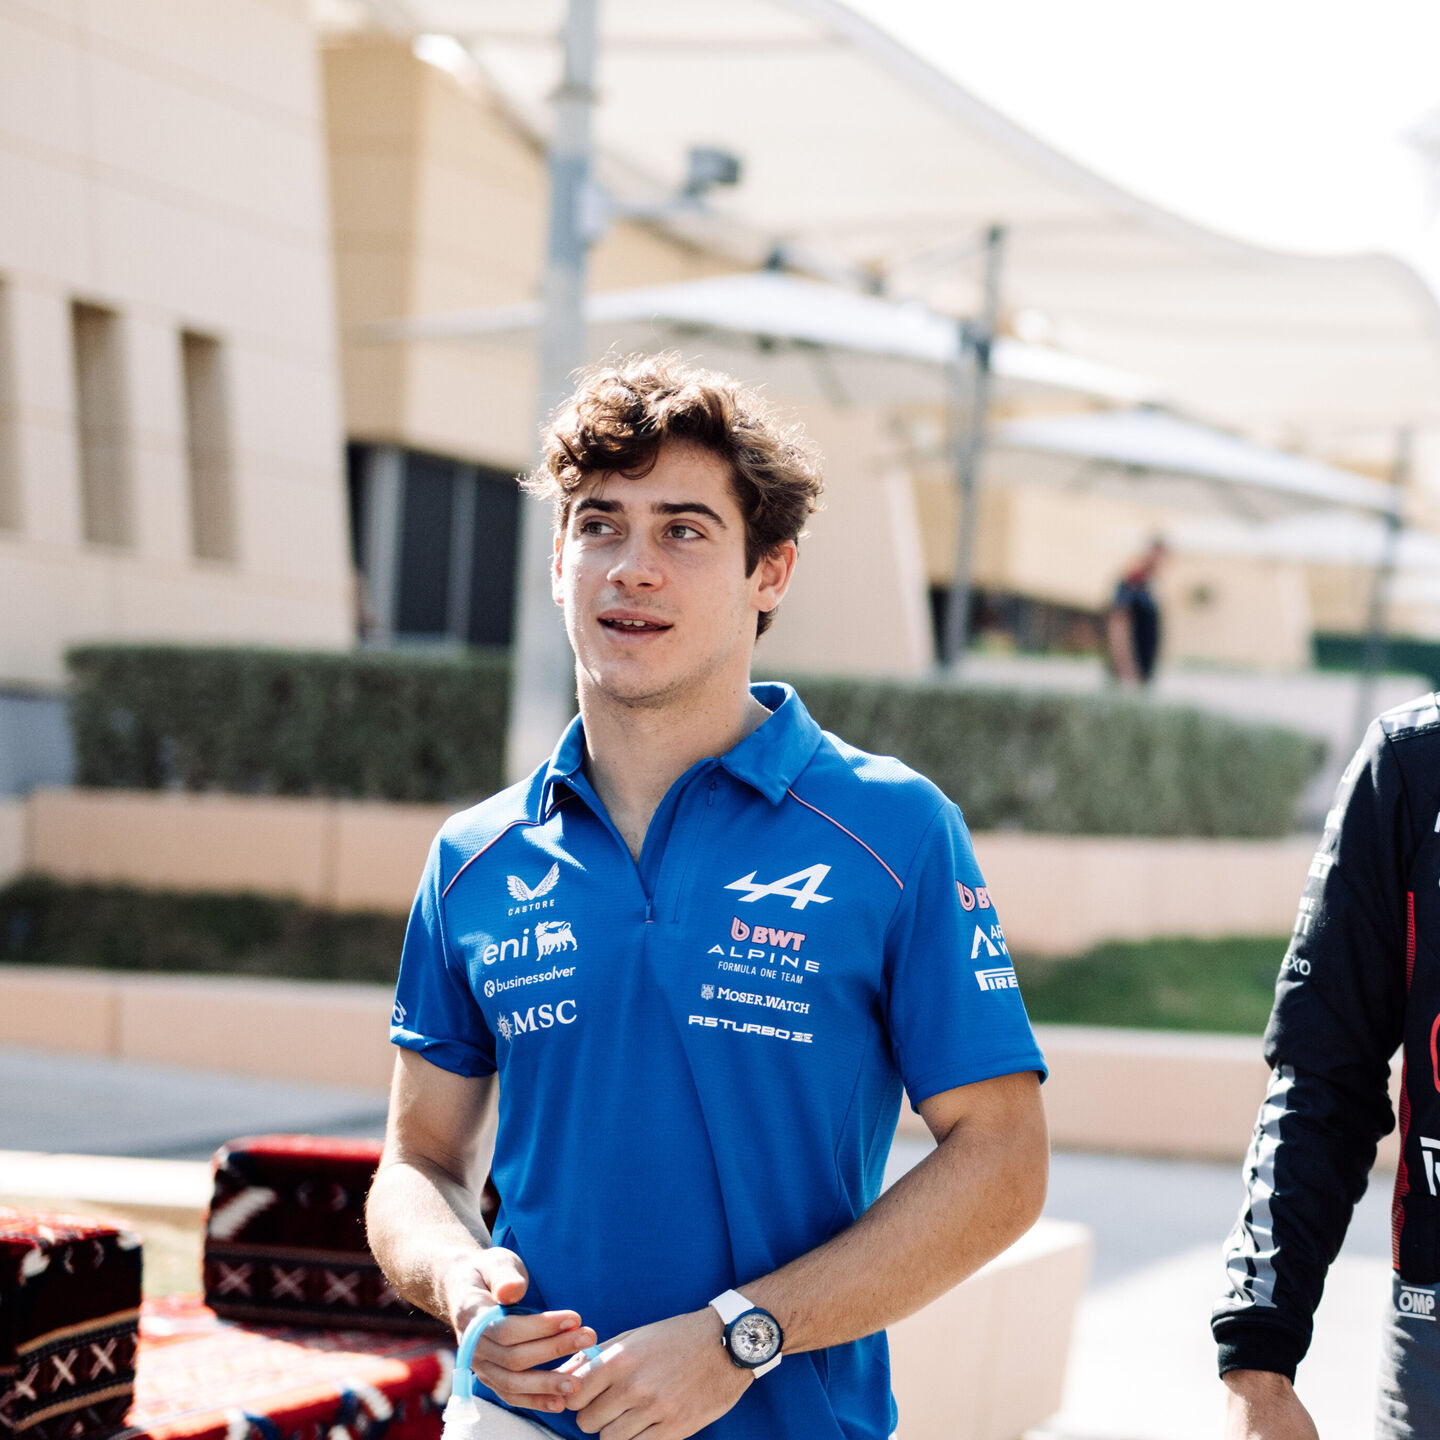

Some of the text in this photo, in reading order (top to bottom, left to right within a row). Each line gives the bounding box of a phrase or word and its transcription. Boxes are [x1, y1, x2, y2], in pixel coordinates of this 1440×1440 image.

[507, 899, 555, 916] CASTORE
[482, 928, 530, 965] eni
[751, 925, 806, 952] BWT
[707, 944, 821, 973] ALPINE
[496, 966, 577, 993] businessolver
[717, 961, 804, 985] FORMULA ONE TEAM
[511, 999, 578, 1035] MSC
[1399, 1291, 1435, 1315] OMP
